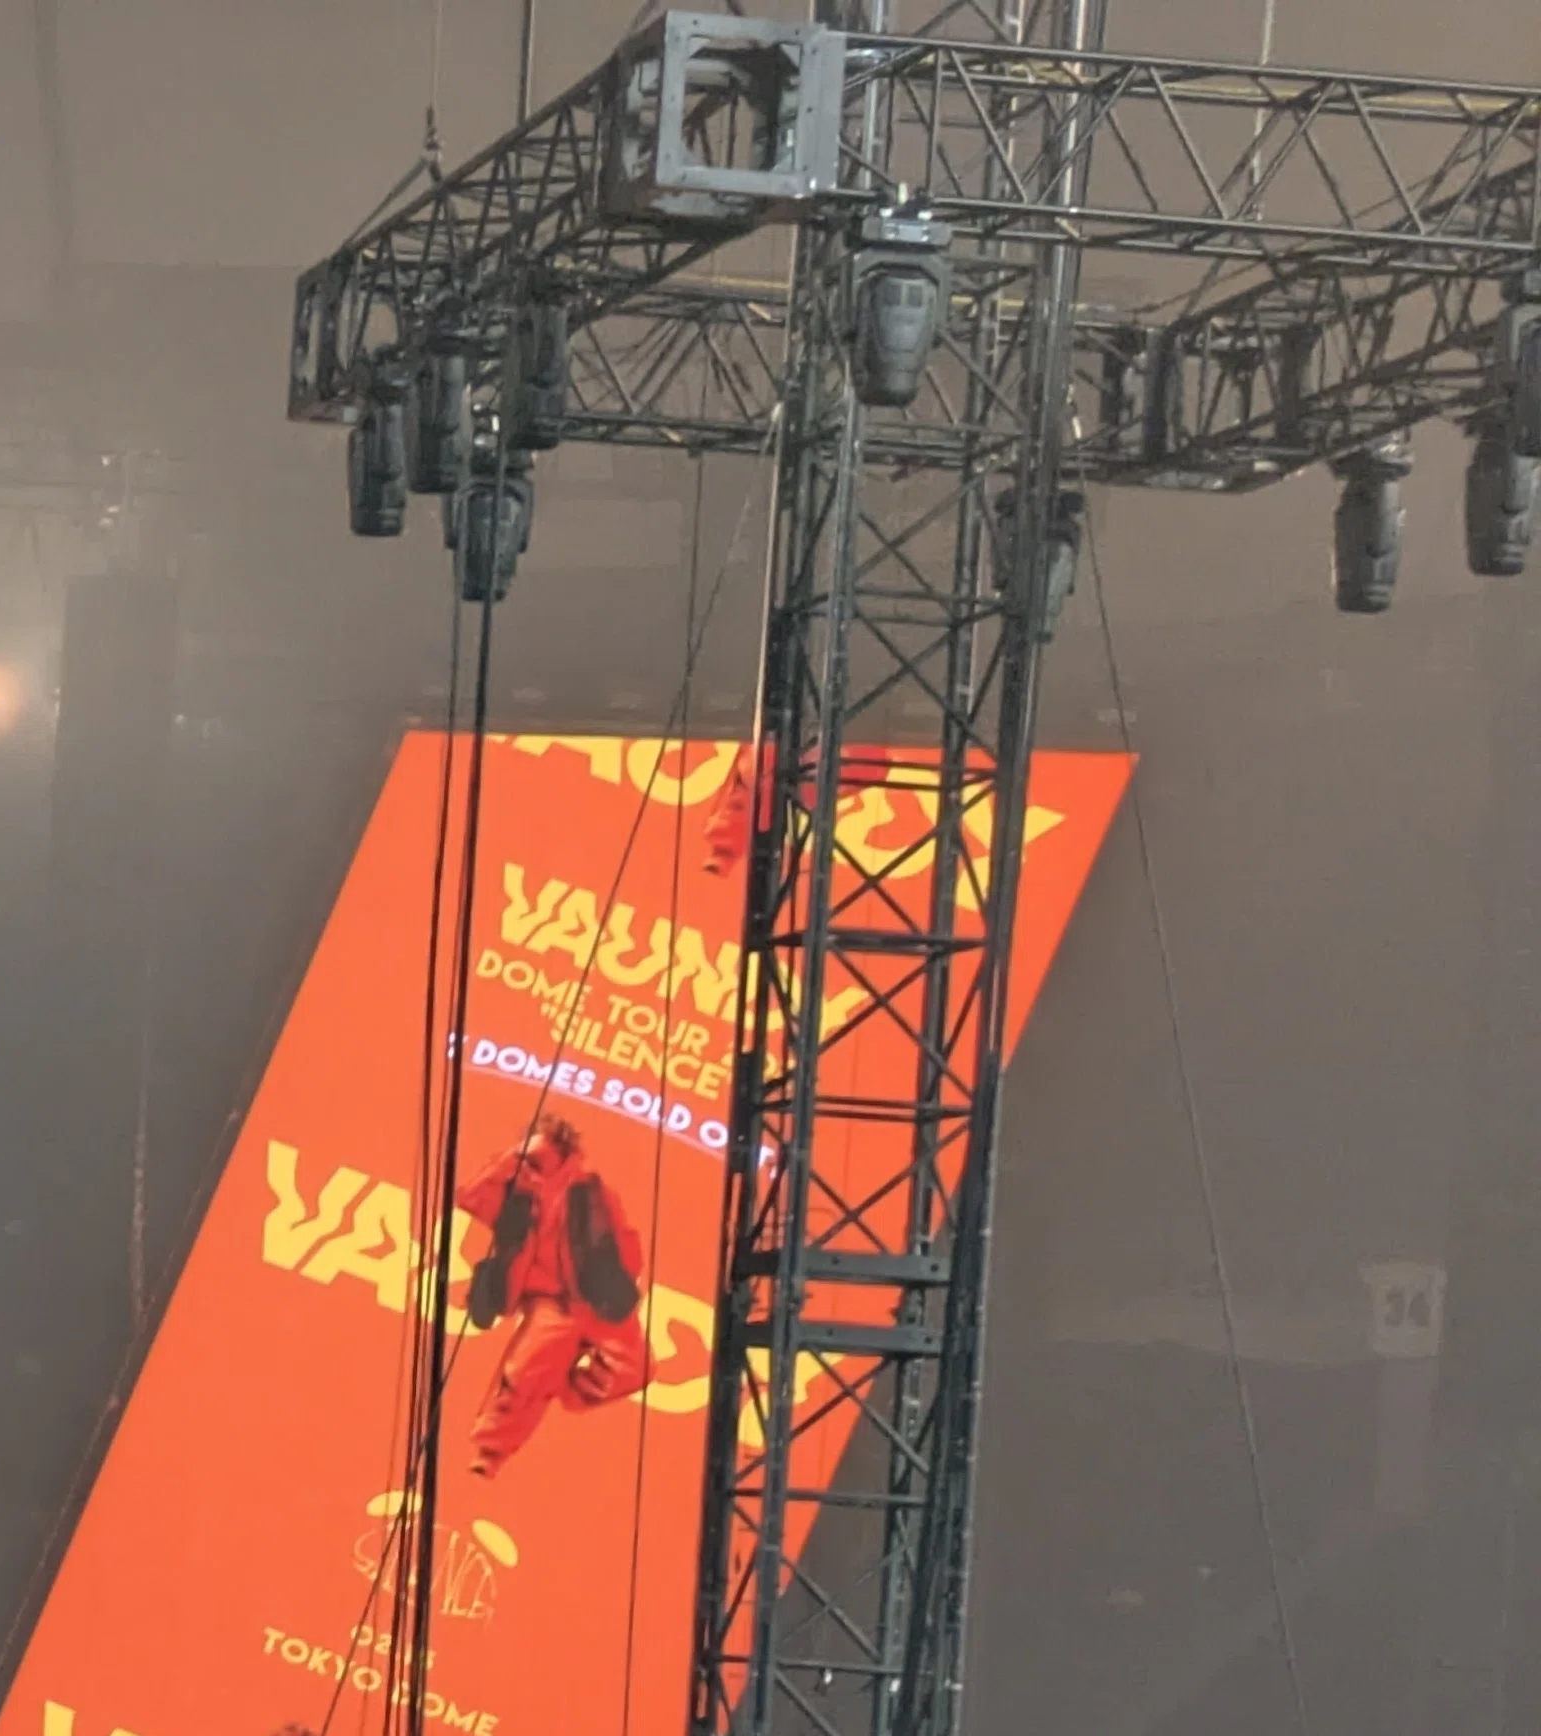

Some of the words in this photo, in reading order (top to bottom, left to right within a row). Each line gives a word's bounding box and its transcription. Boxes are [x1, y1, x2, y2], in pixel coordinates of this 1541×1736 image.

[476, 949, 592, 1012] DOME
[607, 995, 711, 1056] TOUR
[472, 1040, 597, 1096] DOMES
[602, 1078, 692, 1133] SOLD
[263, 1626, 383, 1692] TOKYO
